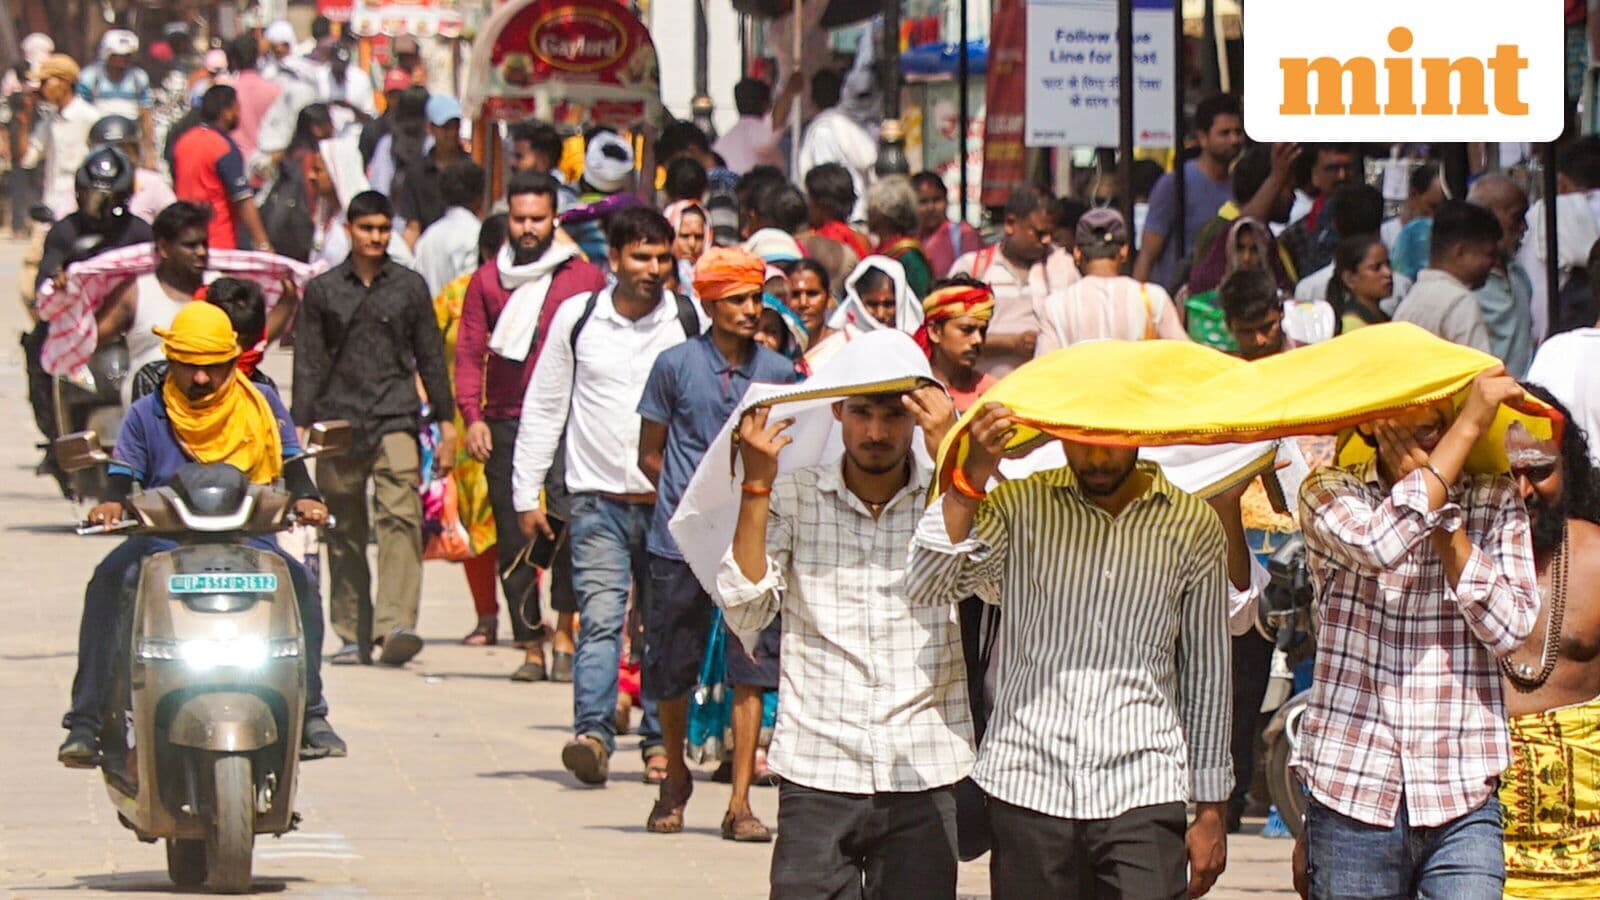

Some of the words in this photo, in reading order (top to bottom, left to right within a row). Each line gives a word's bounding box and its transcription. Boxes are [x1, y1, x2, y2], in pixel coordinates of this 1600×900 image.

[1055, 28, 1111, 43] Follow
[540, 34, 618, 61] Gaylord
[1049, 51, 1084, 64] Line
[1089, 50, 1112, 64] for
